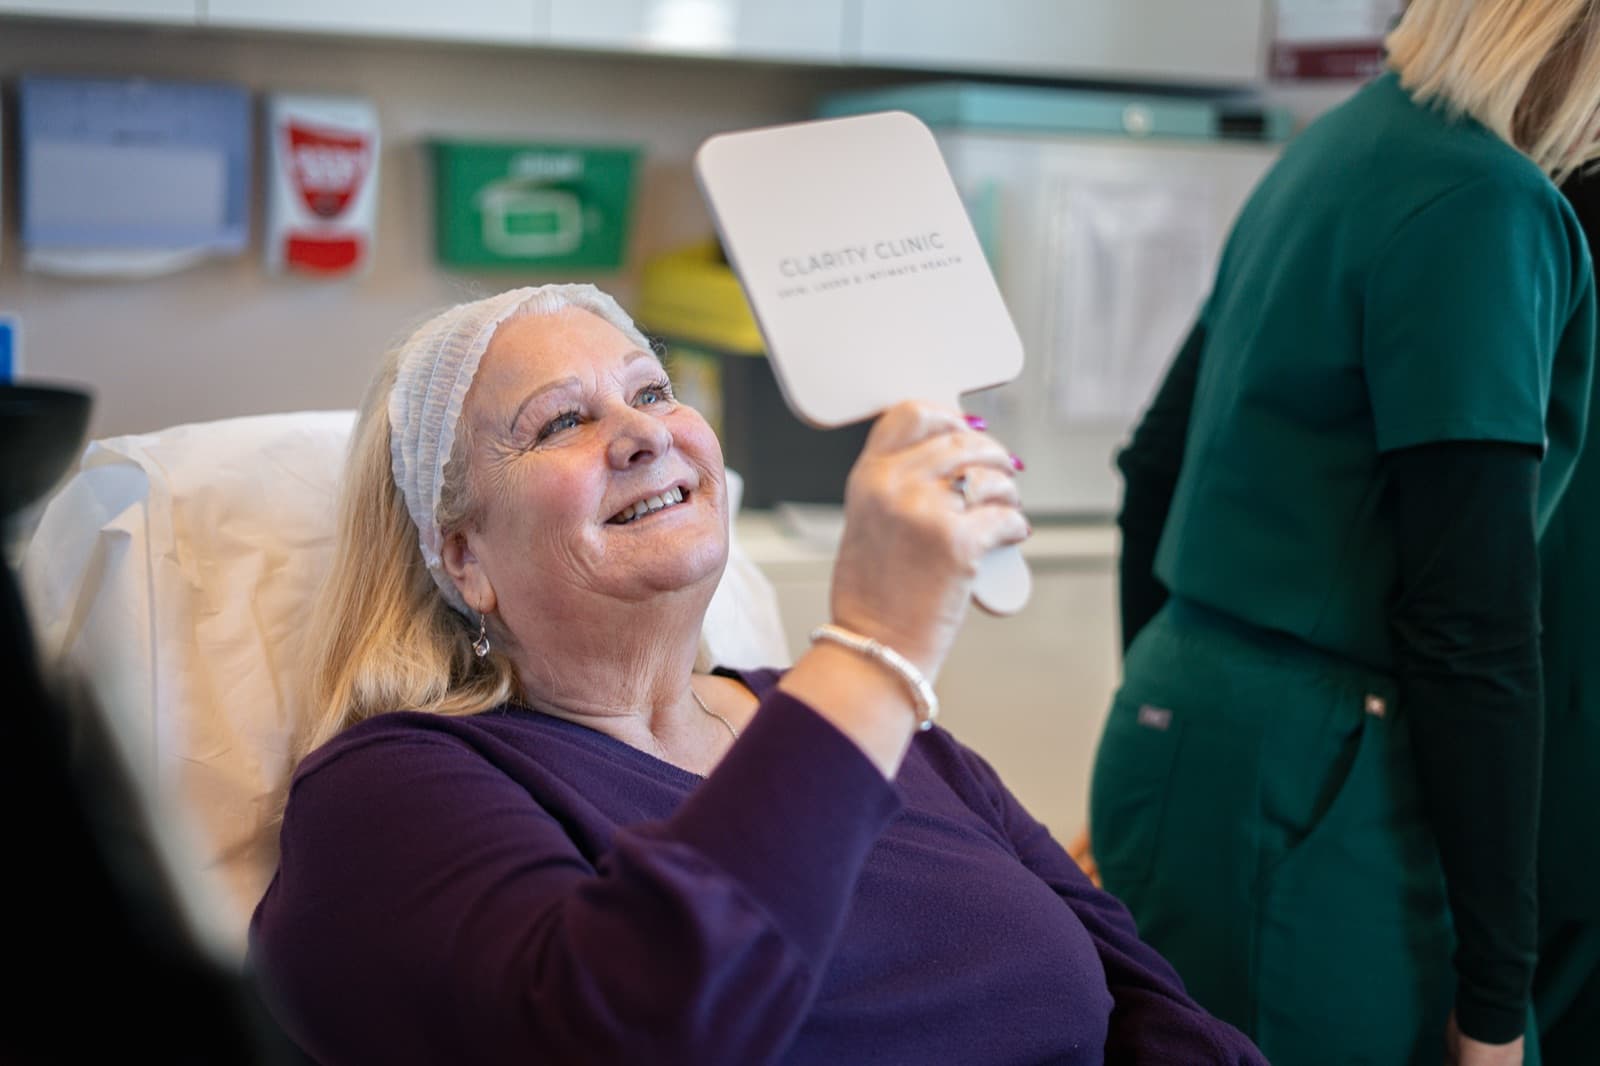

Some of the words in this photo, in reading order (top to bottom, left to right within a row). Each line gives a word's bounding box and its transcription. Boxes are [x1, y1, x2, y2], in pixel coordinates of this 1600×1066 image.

[779, 247, 867, 277] CLARITY
[873, 232, 944, 259] CLINIC
[920, 256, 962, 271] HEALTH
